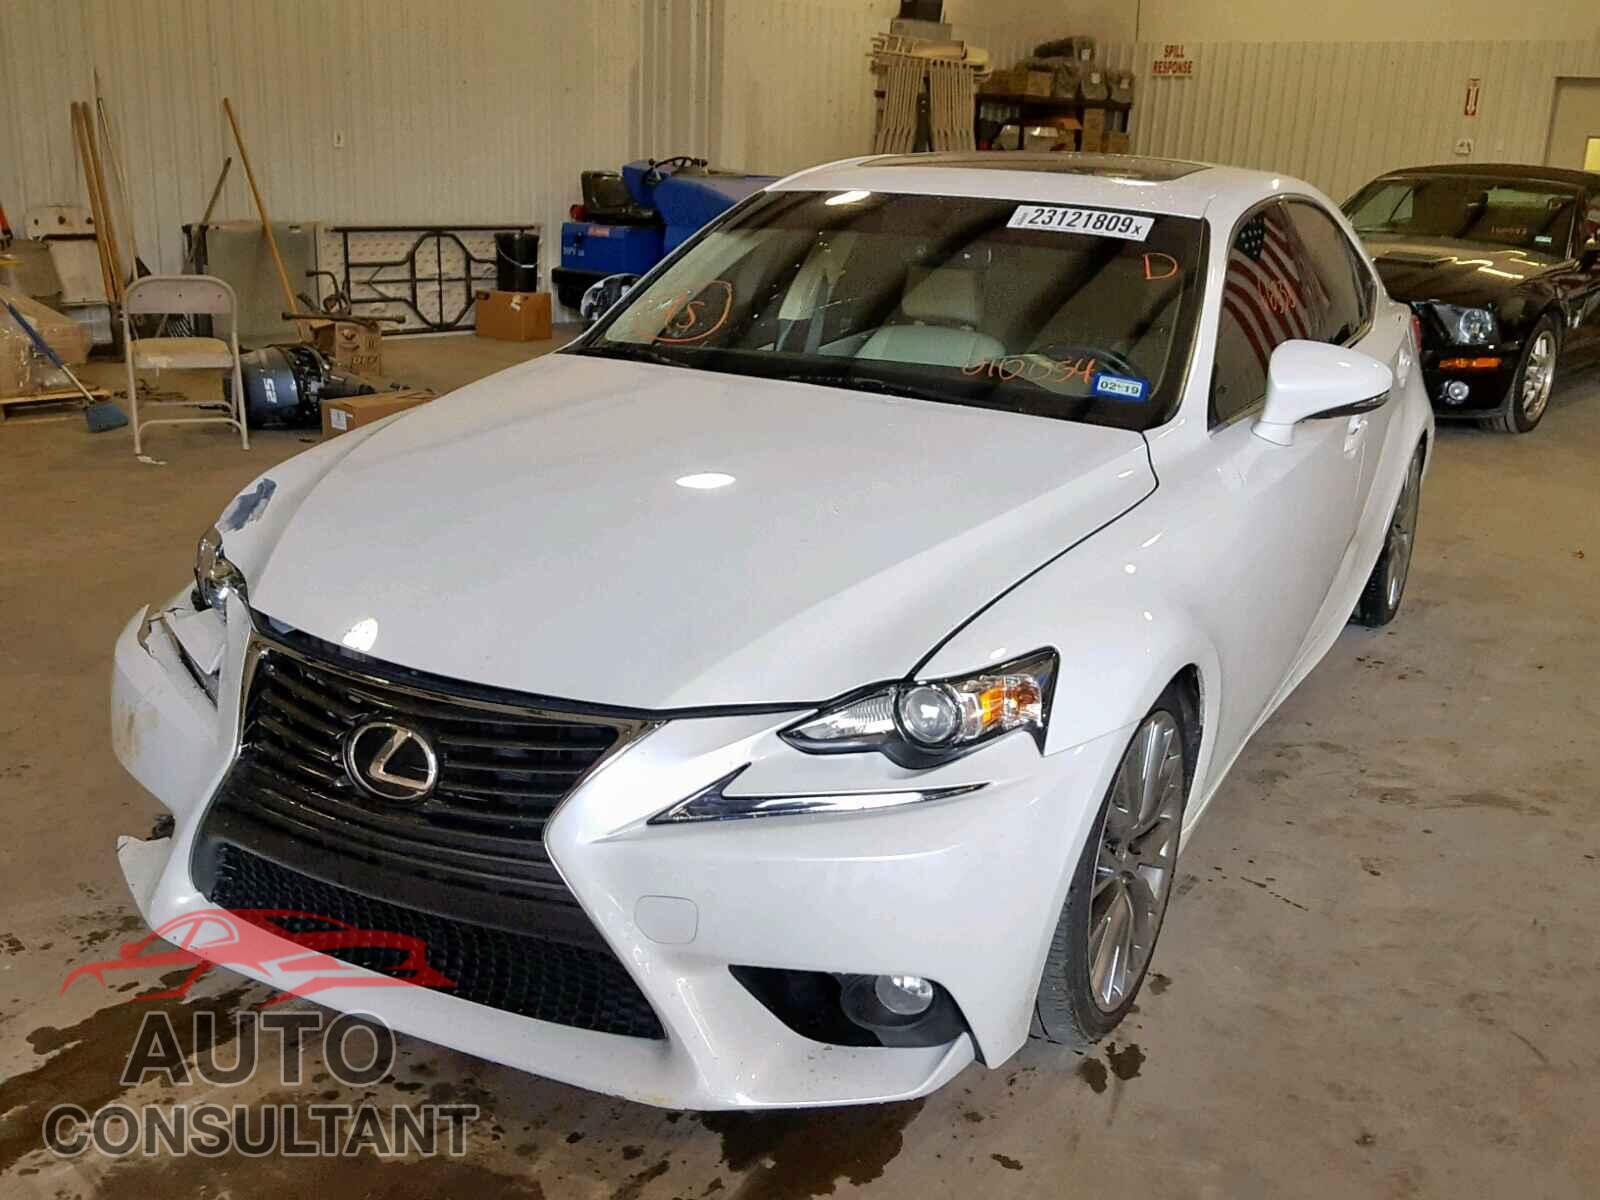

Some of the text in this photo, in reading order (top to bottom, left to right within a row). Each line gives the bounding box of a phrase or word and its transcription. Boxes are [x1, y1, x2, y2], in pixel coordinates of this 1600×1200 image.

[1164, 44, 1184, 57] SPILL
[1152, 60, 1192, 74] RESPONSE
[1142, 252, 1179, 280] D
[1100, 380, 1117, 391] 02
